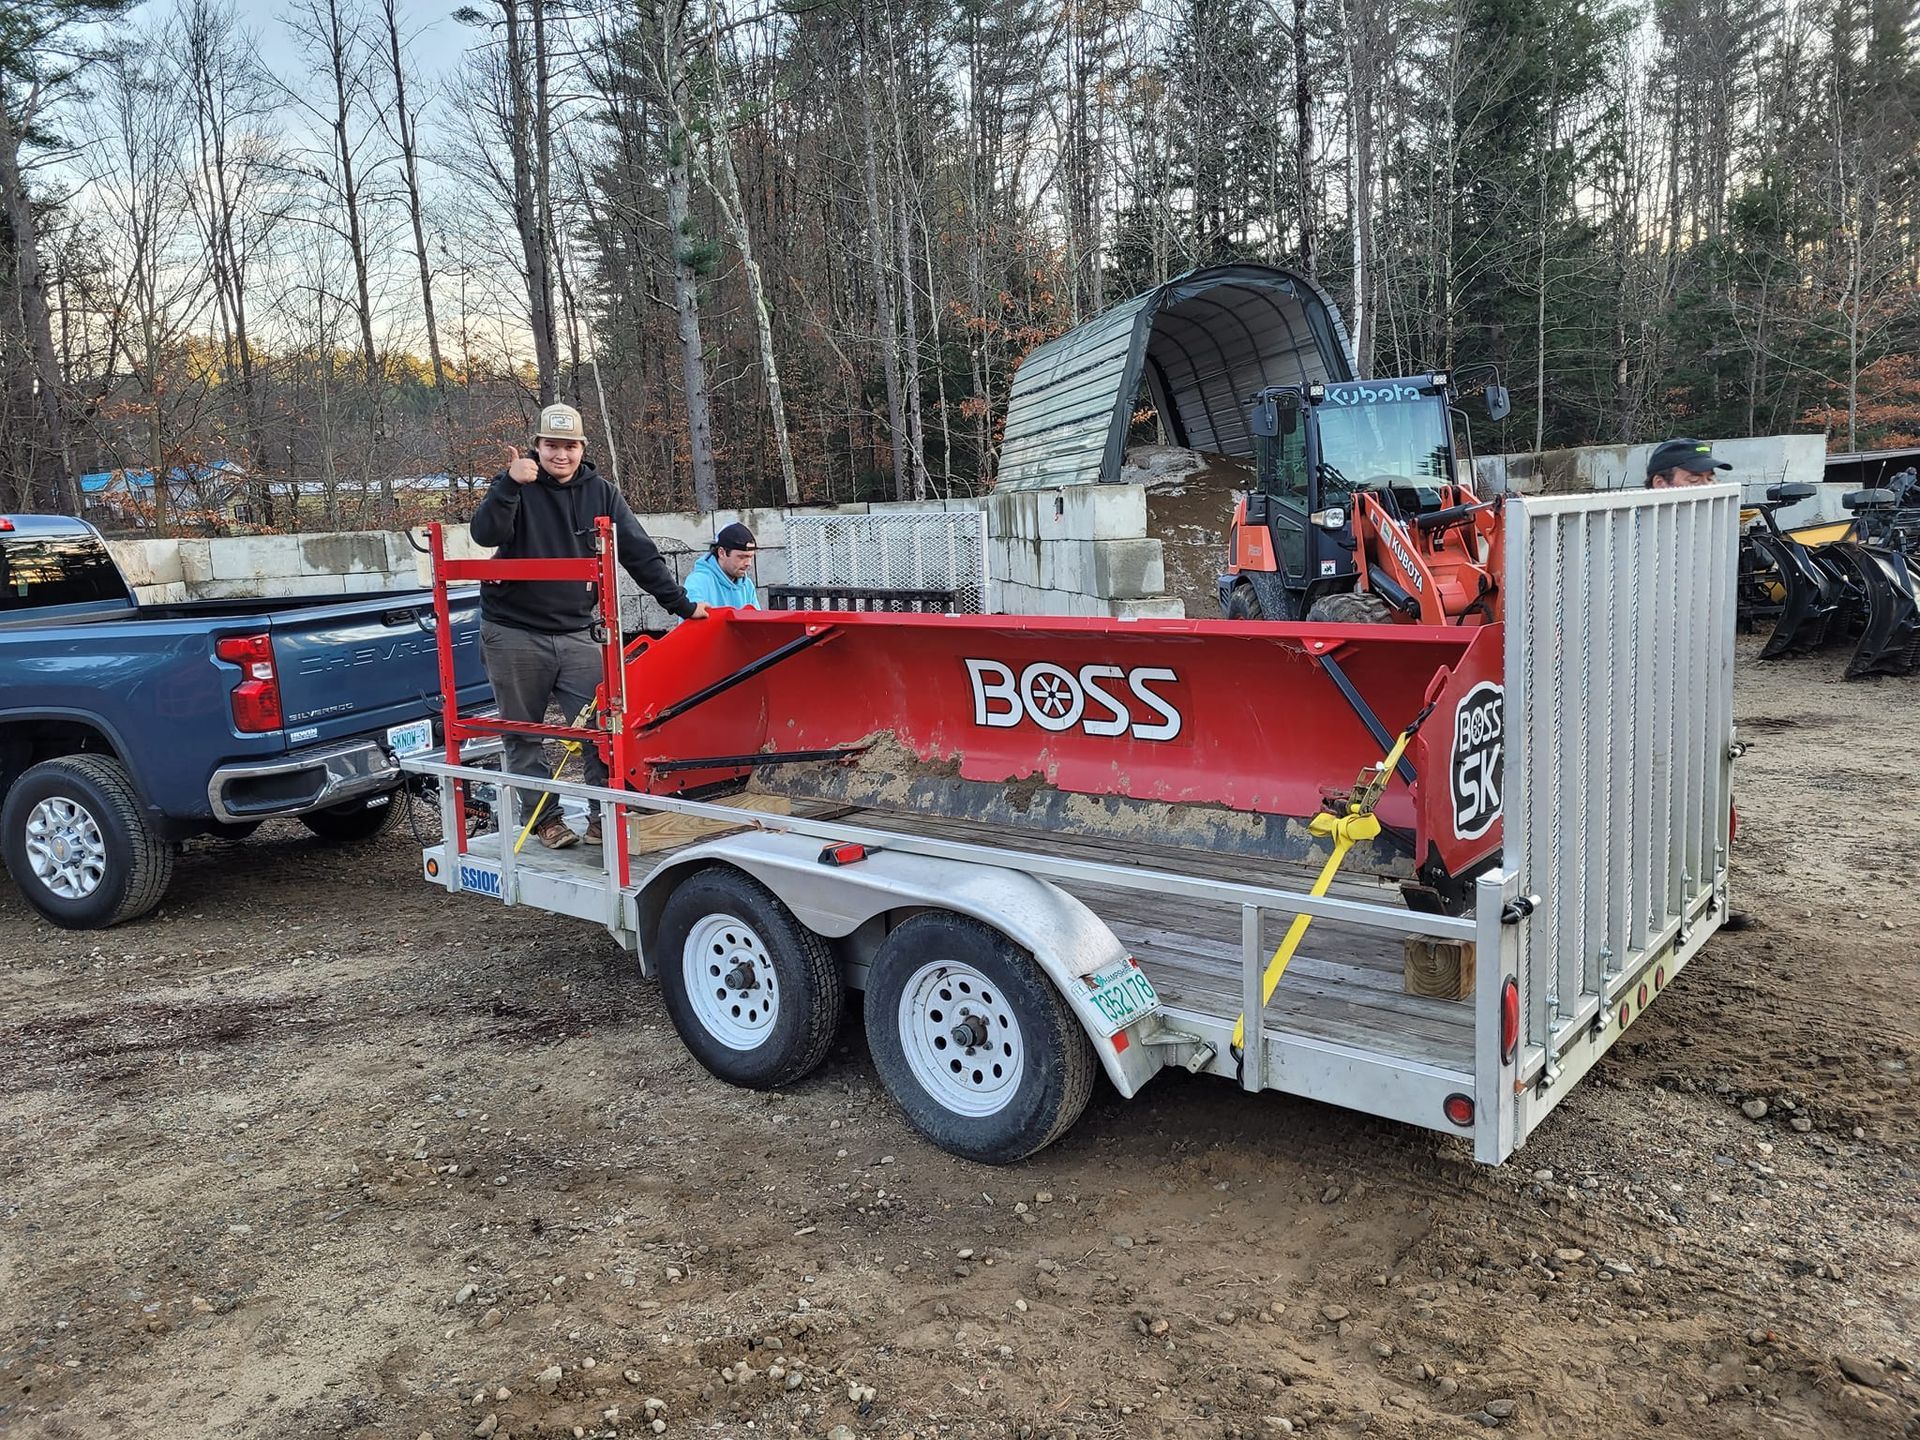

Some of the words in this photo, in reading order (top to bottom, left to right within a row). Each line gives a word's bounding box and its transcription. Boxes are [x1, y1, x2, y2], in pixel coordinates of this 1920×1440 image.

[1324, 384, 1420, 405] Kubota
[1391, 535, 1423, 593] KUBOTA
[288, 702, 354, 721] SILVERADO
[964, 657, 1183, 742] BOSS
[1459, 698, 1502, 753] BOSS
[1458, 742, 1501, 826] SK
[461, 866, 501, 894] ssion
